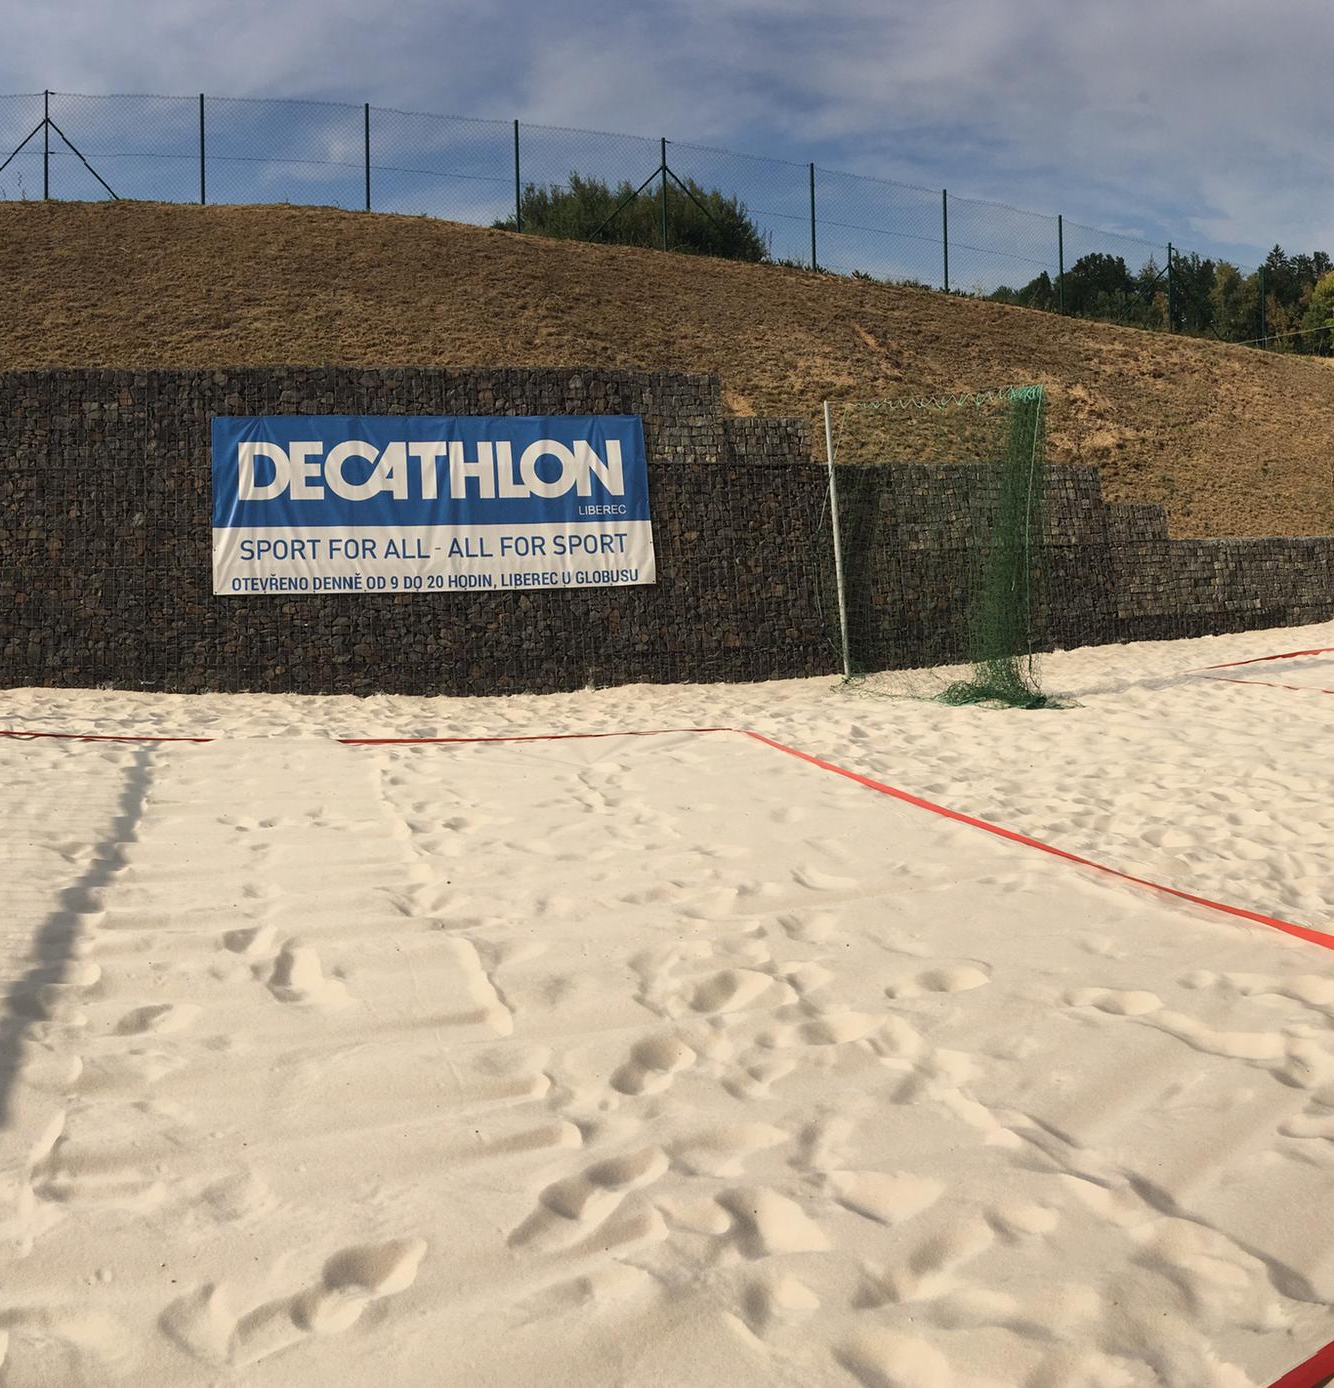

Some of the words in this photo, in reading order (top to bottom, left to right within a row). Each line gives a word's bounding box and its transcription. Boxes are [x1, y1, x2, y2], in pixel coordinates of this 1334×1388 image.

[237, 439, 624, 501] DECATHLON
[578, 504, 627, 516] LIBEREC
[239, 538, 321, 561] SPORT
[328, 538, 377, 560] FOR
[384, 538, 431, 559] ALL
[448, 537, 494, 558] ALL
[500, 535, 546, 557] FOR
[553, 533, 627, 556] SPORT
[231, 573, 308, 592] OTEVŘENO
[313, 572, 363, 590] DENNĚ
[366, 575, 386, 590] OD
[390, 575, 399, 590] 9
[404, 575, 423, 590] DO
[427, 575, 444, 589] 20
[448, 573, 497, 589] HODIN,
[501, 571, 558, 587] LIBEREC
[562, 570, 571, 585] U
[575, 569, 639, 584] GLOBUSU
